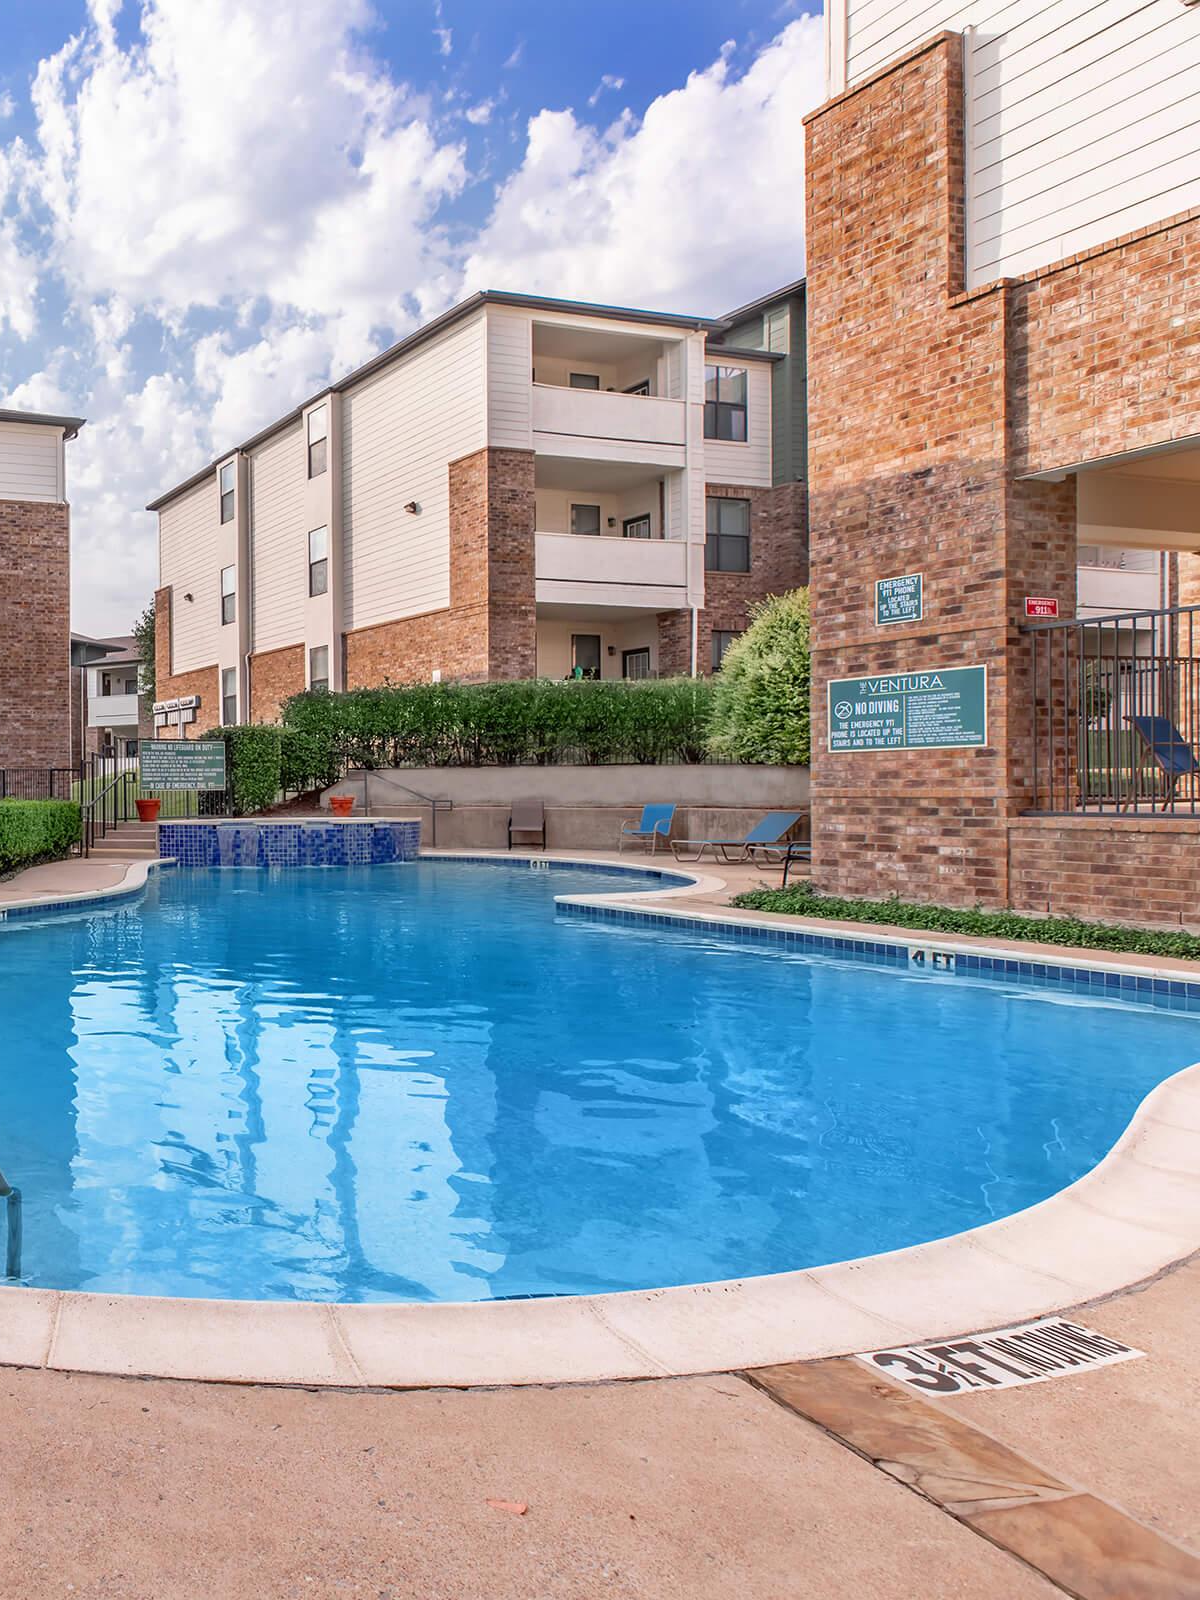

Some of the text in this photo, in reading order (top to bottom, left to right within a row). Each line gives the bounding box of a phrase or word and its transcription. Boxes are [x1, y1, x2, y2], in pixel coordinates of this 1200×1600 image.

[880, 576, 918, 590] EMERGENCY
[882, 585, 915, 597] 911 PHONE
[888, 595, 910, 603] LOCATED
[902, 606, 915, 614] LEFT
[1035, 606, 1047, 614] 911
[868, 675, 943, 693] VENTURA
[855, 702, 867, 715] NO
[839, 719, 895, 729] THE EMERGENCY 911
[858, 729, 880, 737] LOCATED
[883, 728, 890, 736] UP
[892, 727, 903, 735] THE
[832, 739, 850, 747] STAIRS
[852, 738, 864, 746] AND
[887, 736, 901, 744] LEFT
